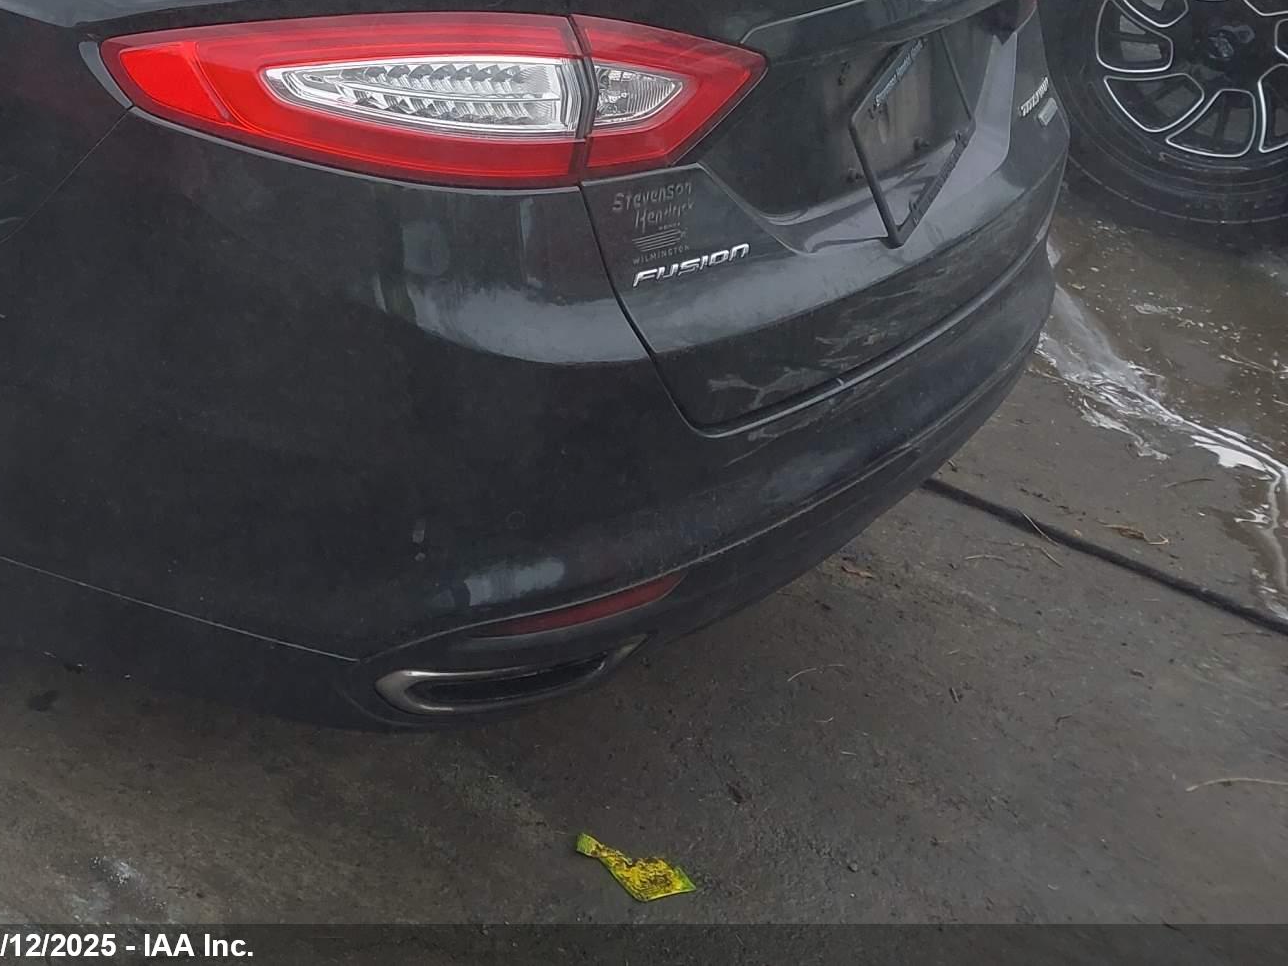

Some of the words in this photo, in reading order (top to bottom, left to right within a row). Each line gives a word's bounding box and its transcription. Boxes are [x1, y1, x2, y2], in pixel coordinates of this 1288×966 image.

[612, 182, 692, 212] Stevenson
[634, 199, 695, 234] Hendrick
[632, 244, 690, 265] WILMINGTON
[633, 243, 750, 288] FUSION
